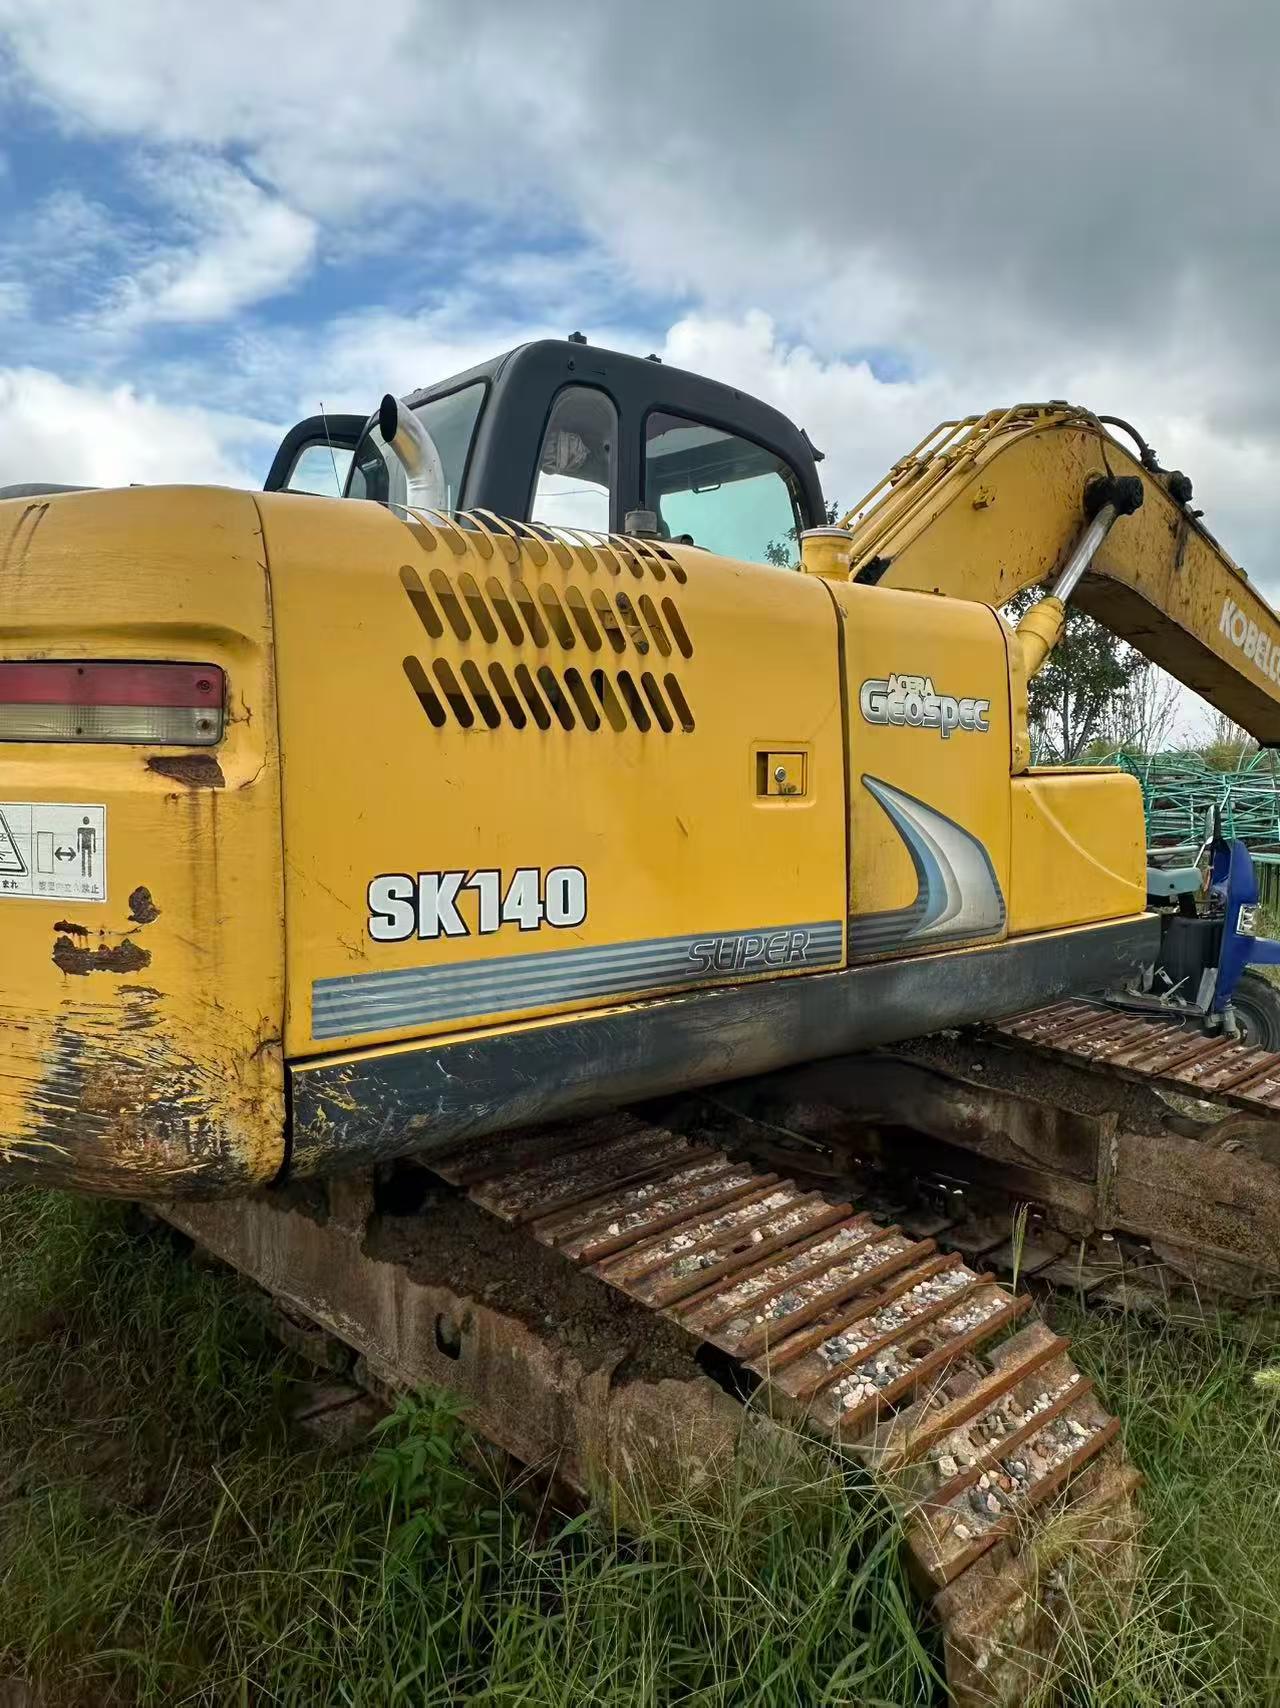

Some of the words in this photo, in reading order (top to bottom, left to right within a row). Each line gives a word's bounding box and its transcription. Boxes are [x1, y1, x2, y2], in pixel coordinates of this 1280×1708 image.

[1219, 597, 1280, 687] KOBELC
[887, 673, 936, 697] ACERA
[367, 866, 587, 942] SK140
[686, 929, 812, 976] SUPER
